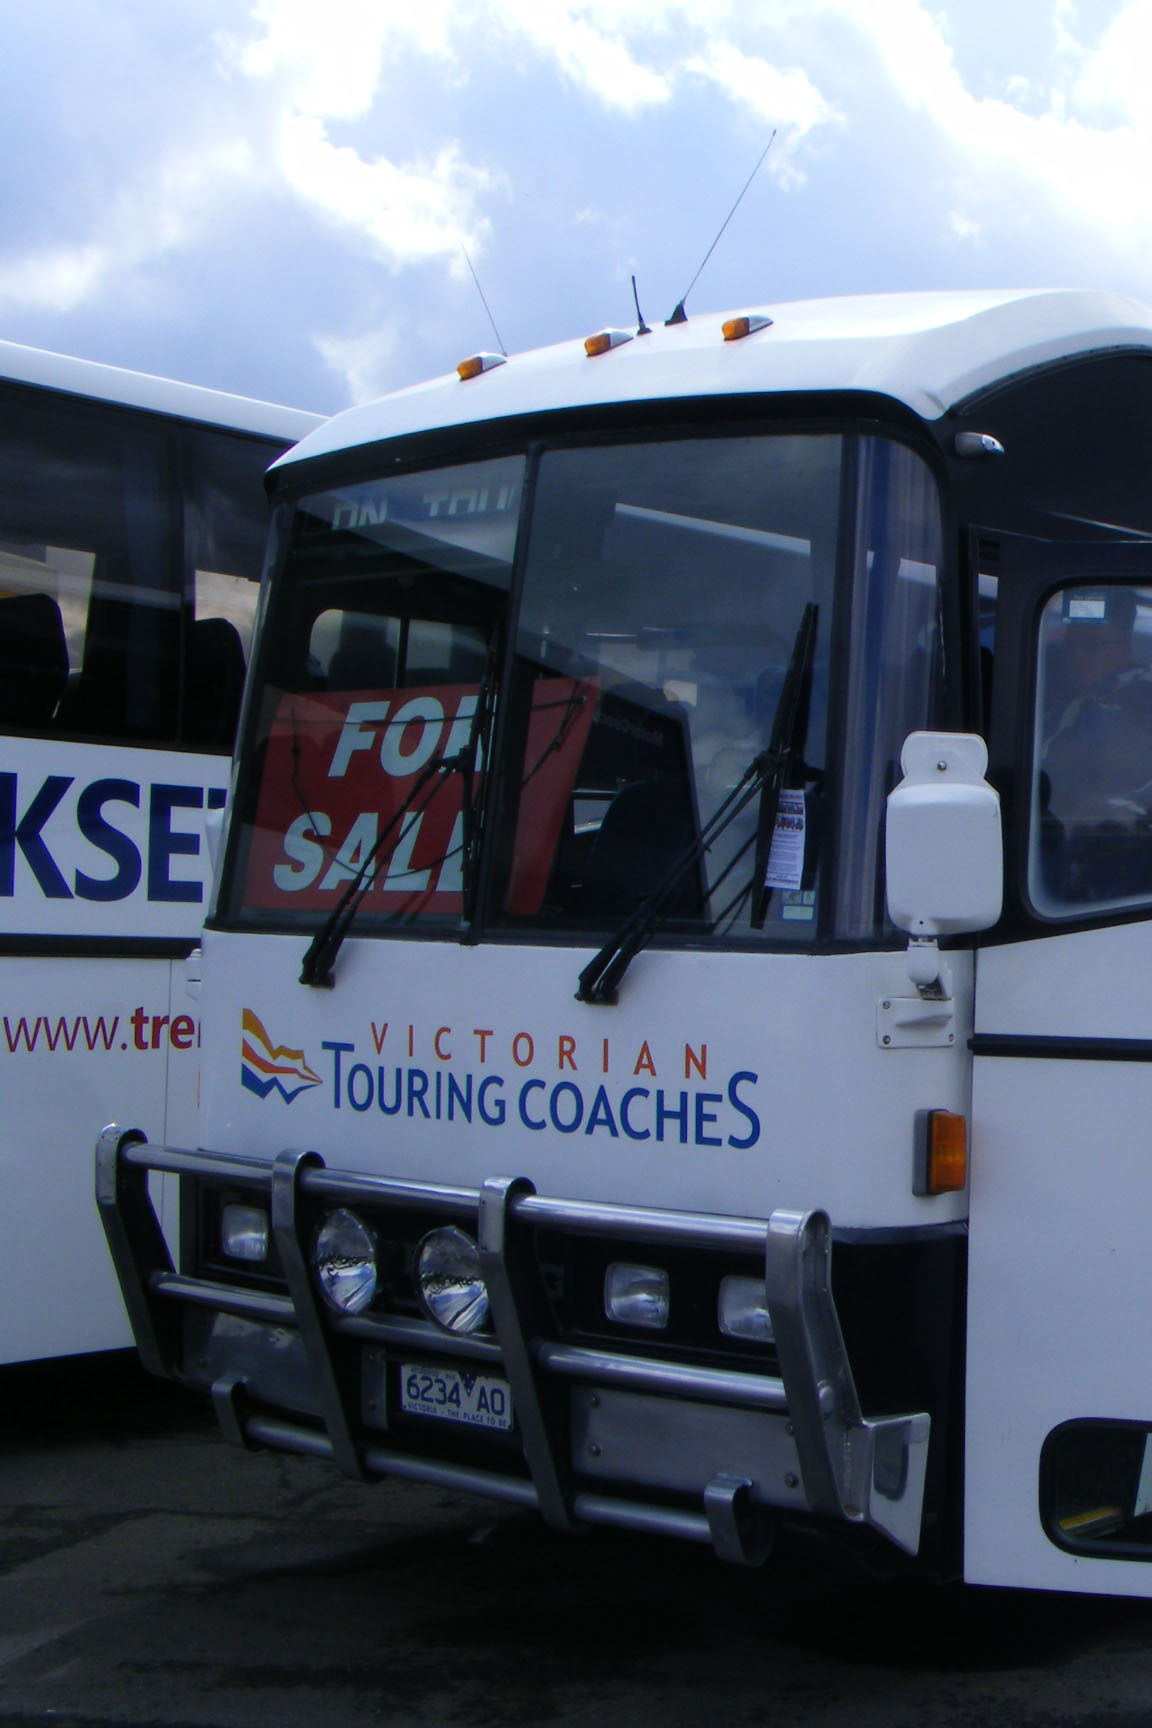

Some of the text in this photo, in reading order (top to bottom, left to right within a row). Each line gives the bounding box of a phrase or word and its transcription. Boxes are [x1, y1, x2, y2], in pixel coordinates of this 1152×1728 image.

[0, 771, 228, 903] KSE
[2, 1006, 200, 1052] www.tre
[371, 1021, 708, 1080] VICTORIAN
[321, 1040, 761, 1150] TOURING COACHES
[406, 1374, 462, 1408] 6234
